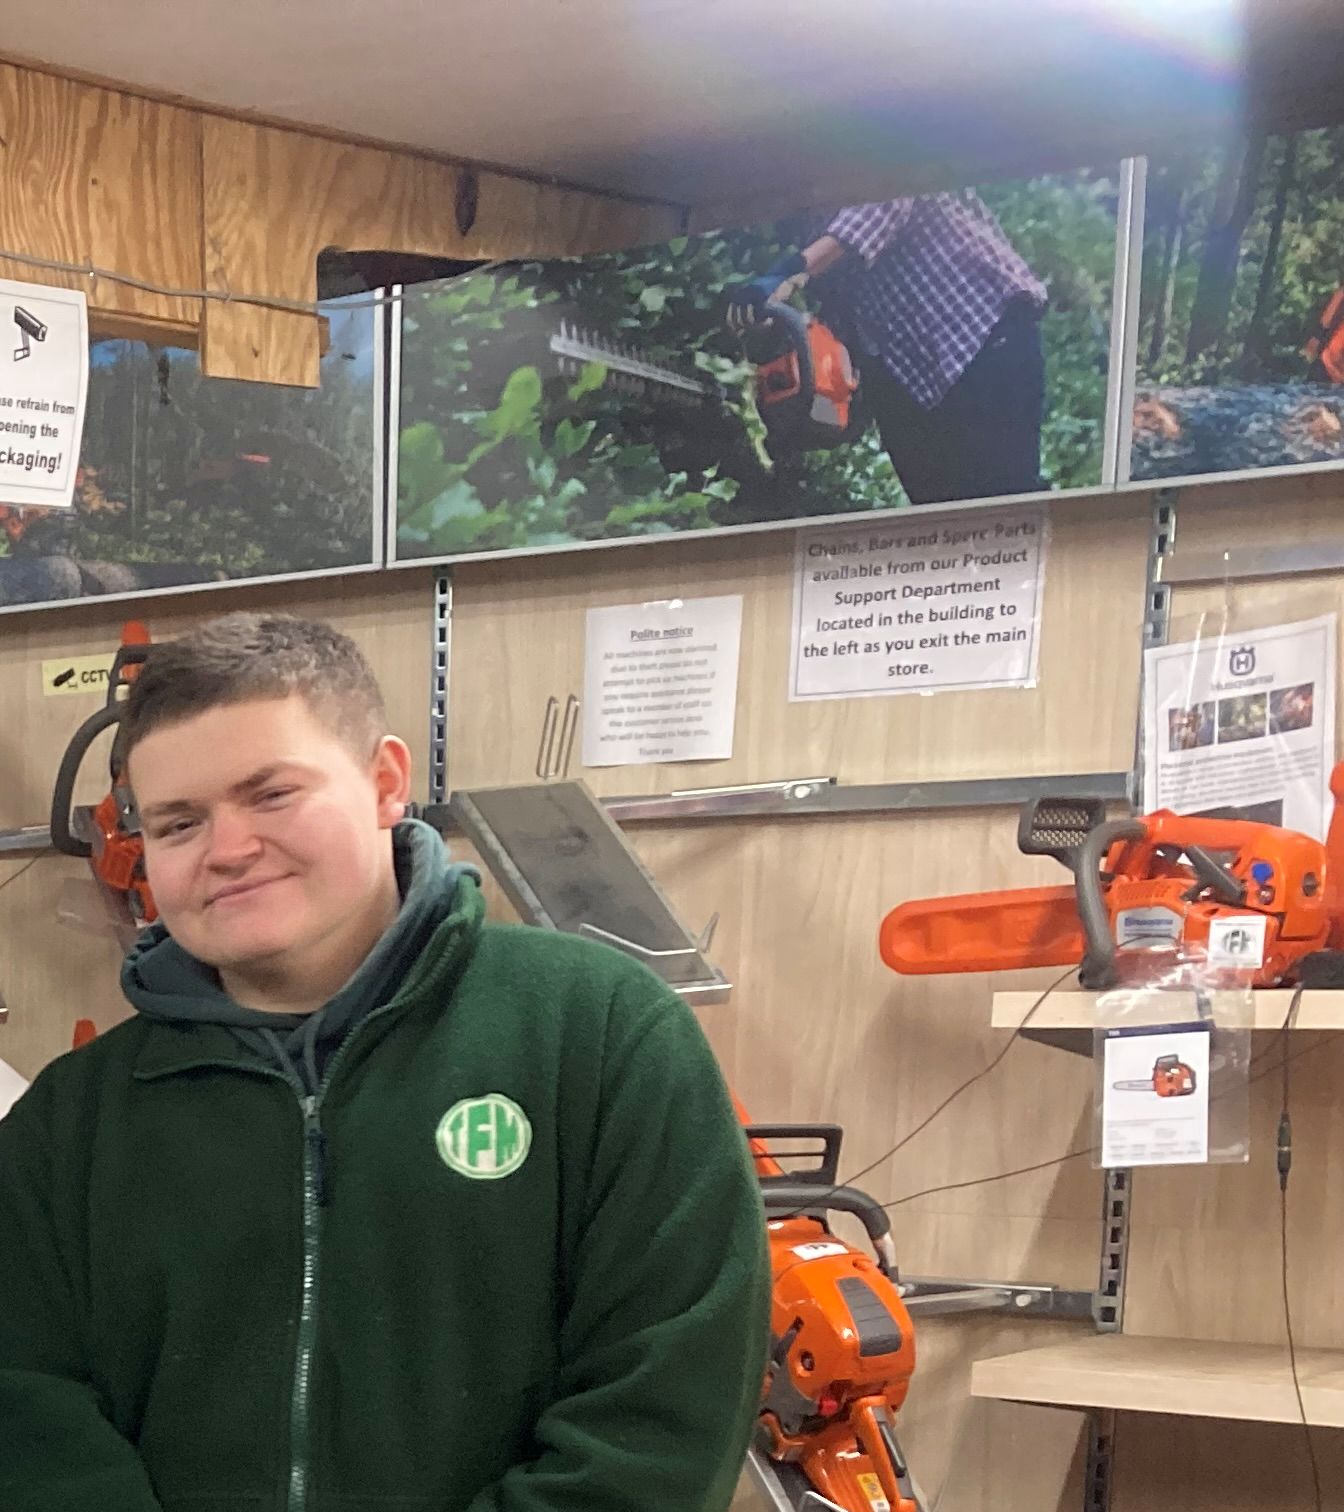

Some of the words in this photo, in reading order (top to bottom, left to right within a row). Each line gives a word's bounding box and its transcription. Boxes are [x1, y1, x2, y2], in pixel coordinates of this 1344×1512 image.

[16, 398, 50, 412] refrain
[52, 400, 75, 415] from
[40, 423, 59, 438] the
[807, 541, 865, 558] Chains,
[906, 532, 939, 548] and
[993, 521, 1037, 538] Parts
[813, 561, 882, 582] available
[886, 557, 926, 575] from
[930, 554, 958, 570] our
[962, 549, 1029, 568] Product
[834, 587, 898, 608] Support
[901, 577, 1002, 602] Department
[816, 613, 874, 632] located
[878, 612, 893, 627] in
[897, 610, 924, 625] the
[928, 603, 995, 623] building
[999, 604, 1018, 617] to
[803, 643, 830, 659] the
[832, 639, 860, 655] left
[863, 640, 881, 653] as
[885, 639, 915, 654] you
[918, 632, 950, 649] exit
[953, 630, 982, 646] the
[985, 627, 1028, 644] main
[887, 662, 935, 677] store.
